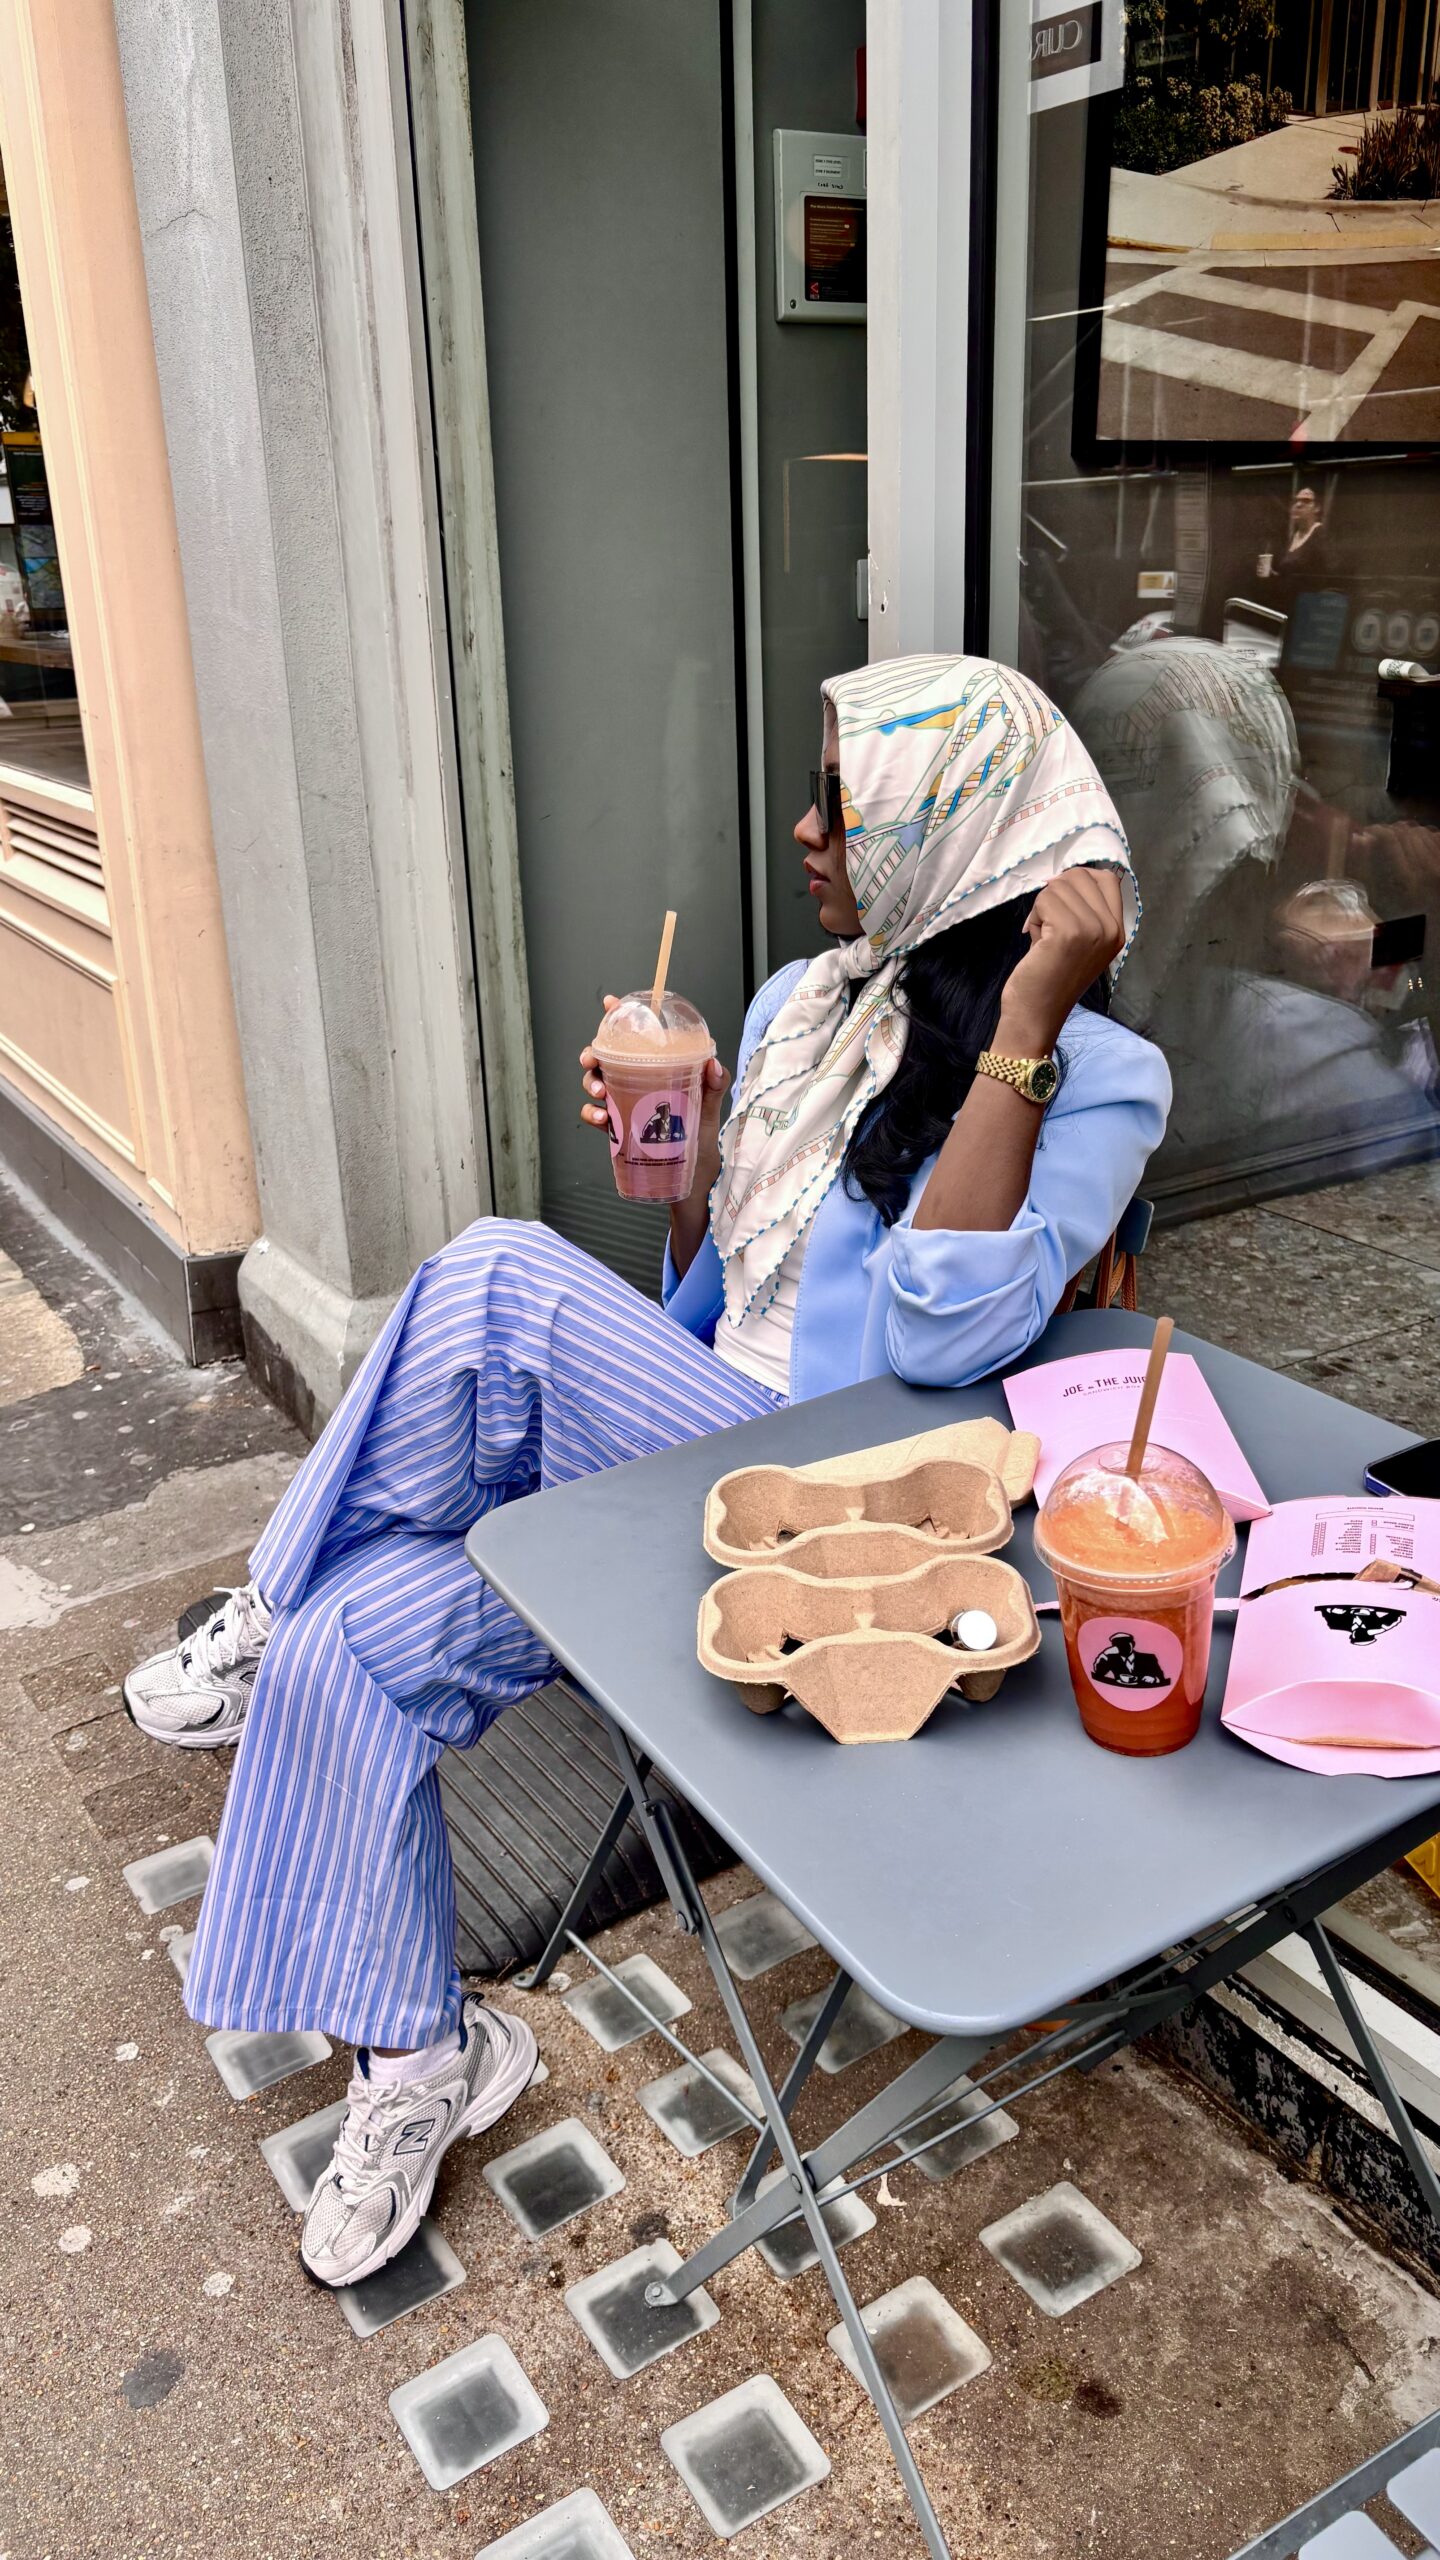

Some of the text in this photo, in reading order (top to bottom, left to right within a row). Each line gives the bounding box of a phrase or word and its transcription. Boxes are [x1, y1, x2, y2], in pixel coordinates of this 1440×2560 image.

[1062, 1383, 1084, 1398] JOE
[1094, 1377, 1120, 1388] THE
[1122, 1376, 1147, 1384] JUIC
